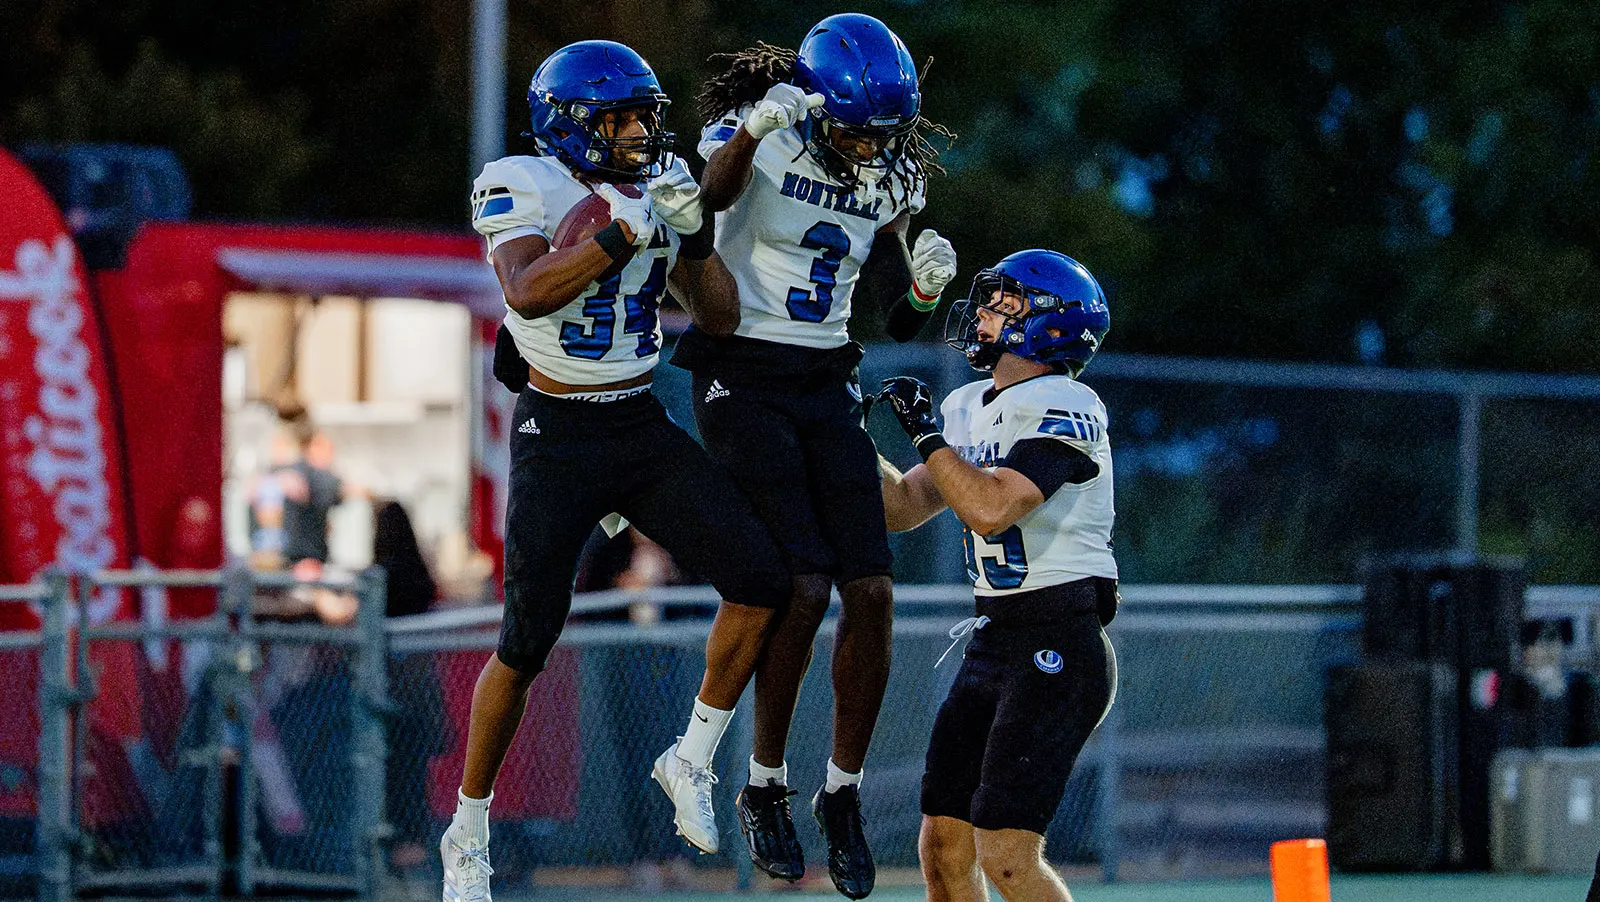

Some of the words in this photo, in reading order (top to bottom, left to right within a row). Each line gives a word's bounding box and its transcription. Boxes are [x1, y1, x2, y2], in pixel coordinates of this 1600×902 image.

[559, 256, 669, 360] 34
[785, 220, 851, 323] 3
[705, 389, 730, 403] adidas
